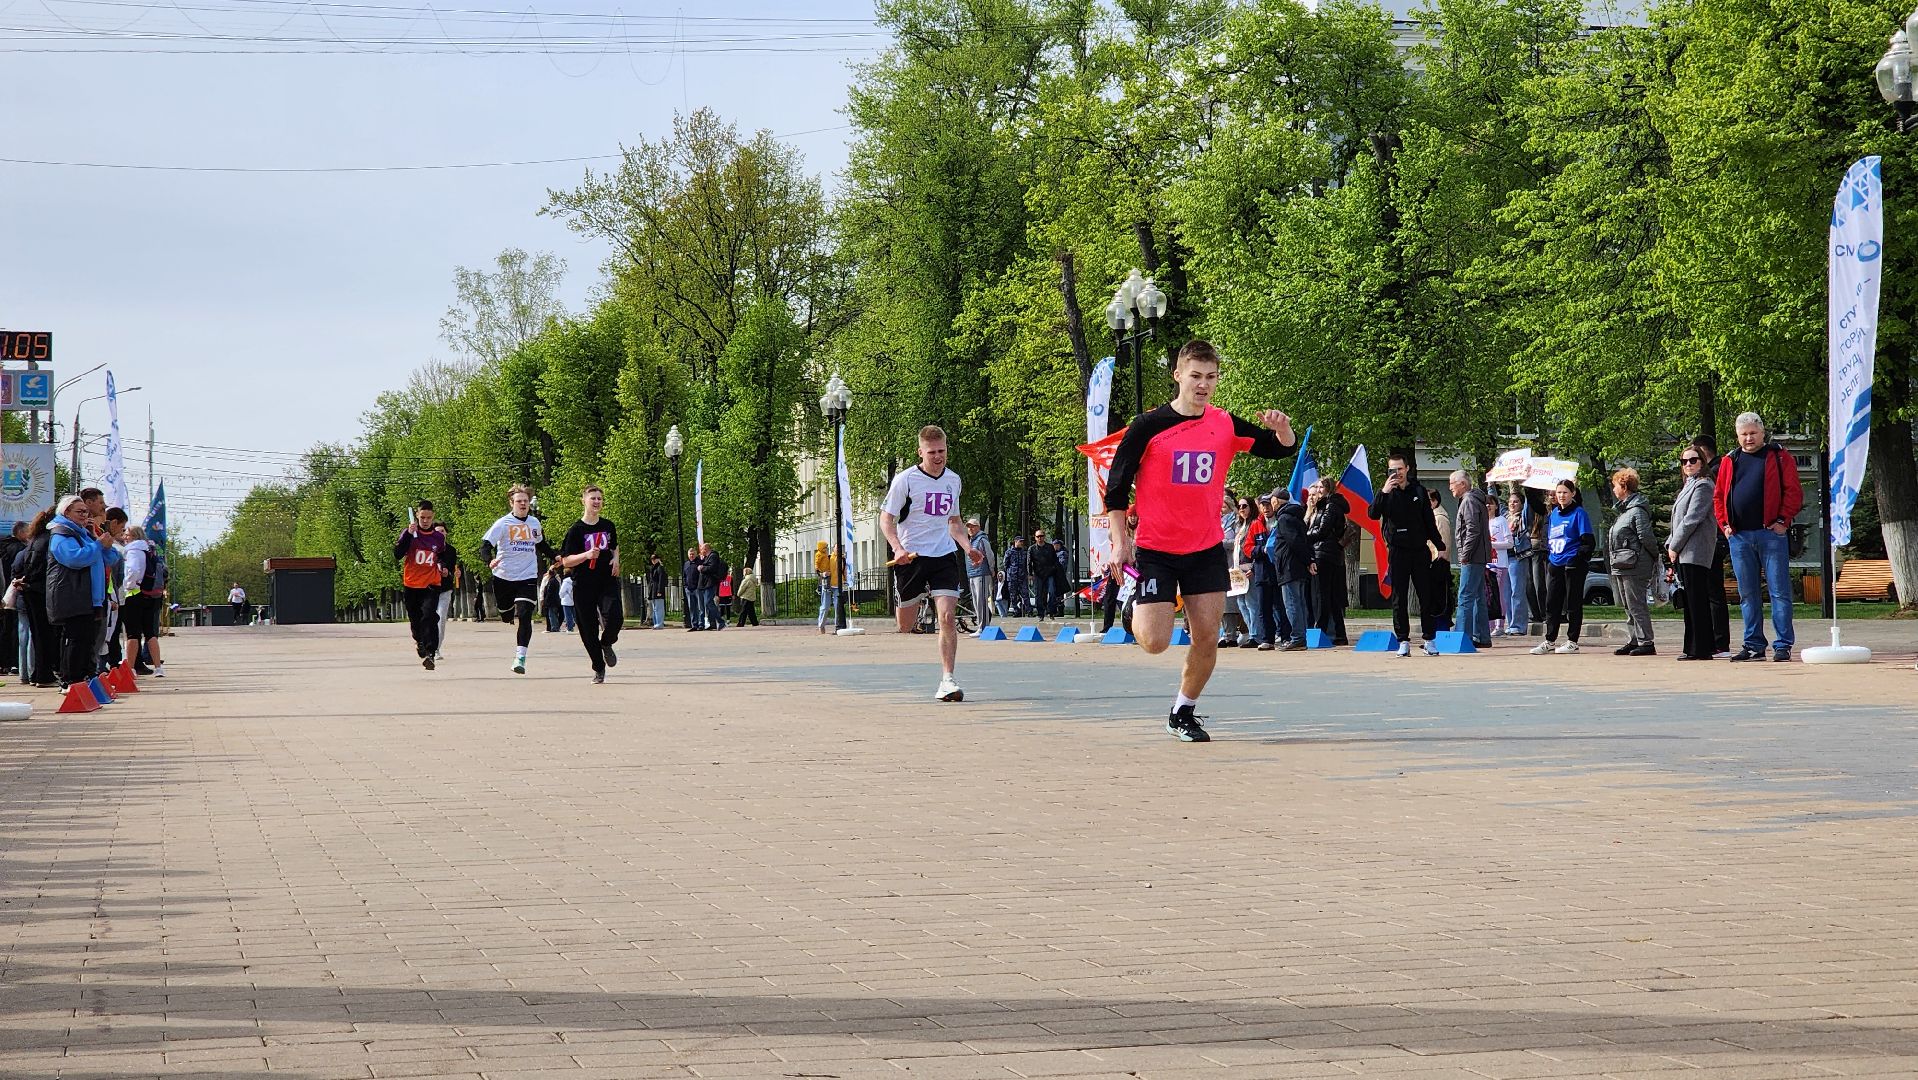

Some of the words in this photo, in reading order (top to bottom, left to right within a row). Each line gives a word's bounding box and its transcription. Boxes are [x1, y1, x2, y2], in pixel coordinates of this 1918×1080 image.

[1177, 453, 1213, 483] 18
[928, 494, 951, 515] 15
[512, 525, 530, 540] 21
[1549, 538, 1567, 554] 30
[415, 550, 434, 566] 04
[1140, 579, 1158, 597] 14
